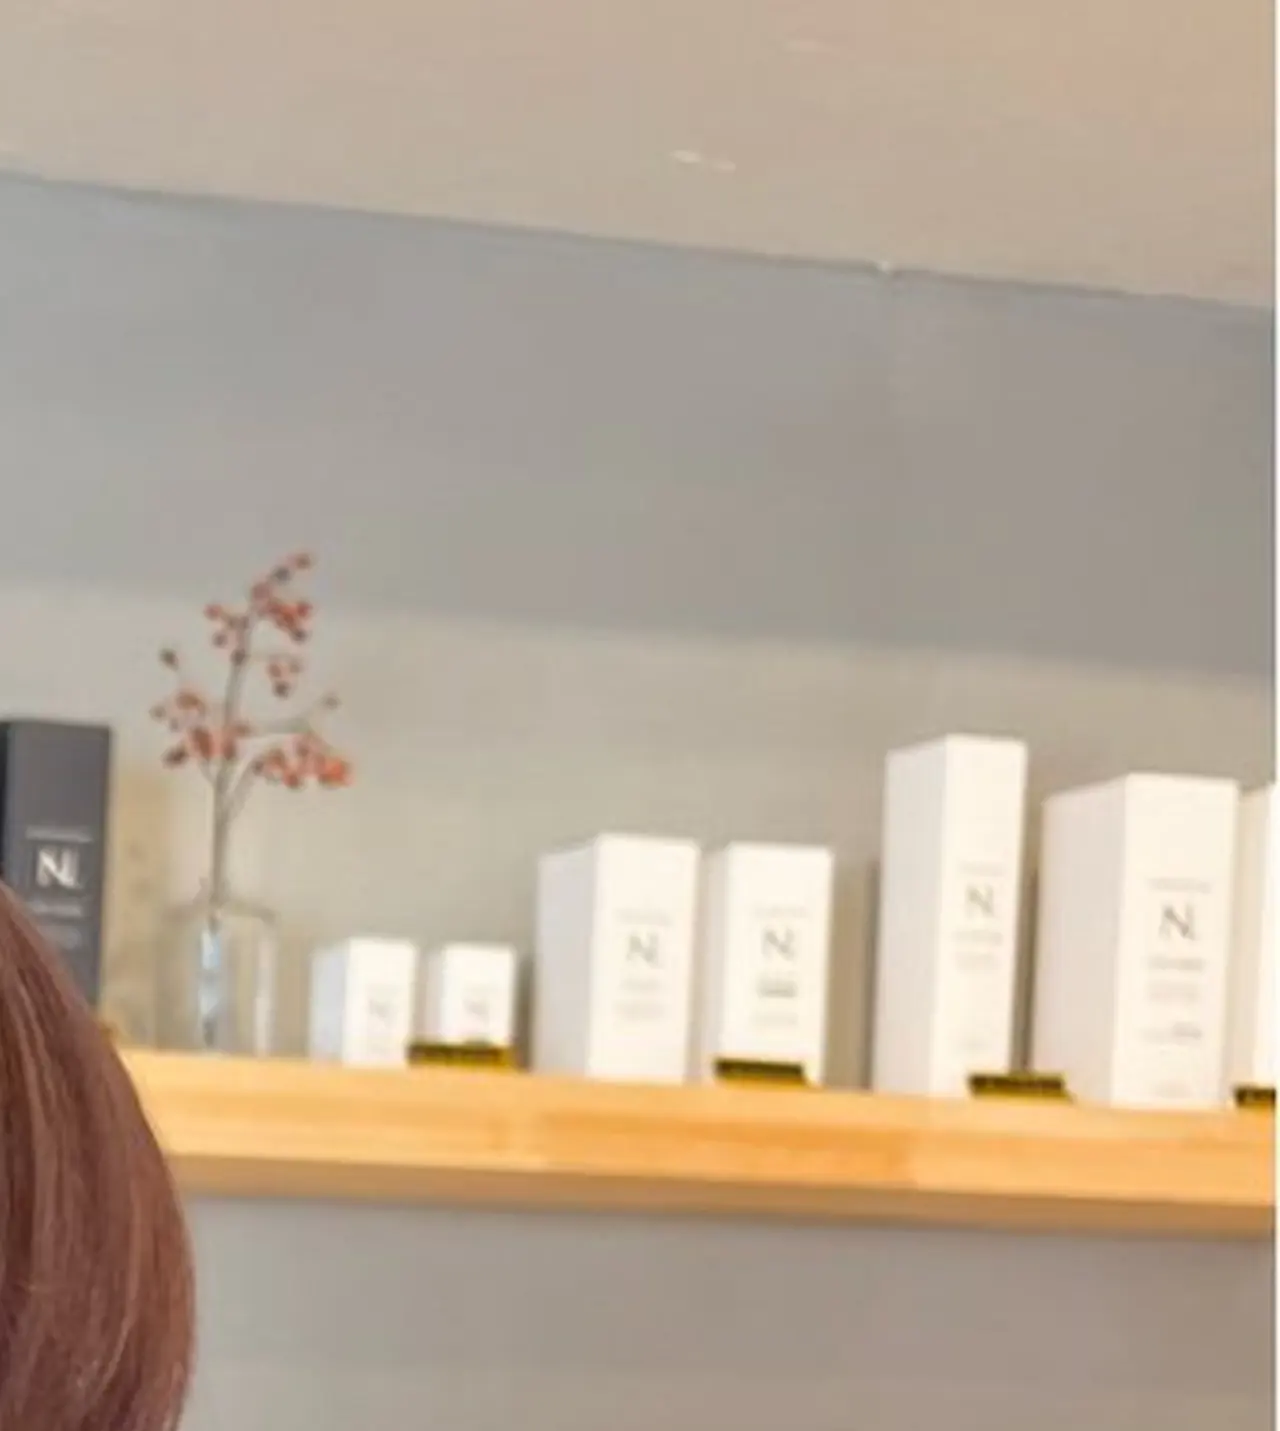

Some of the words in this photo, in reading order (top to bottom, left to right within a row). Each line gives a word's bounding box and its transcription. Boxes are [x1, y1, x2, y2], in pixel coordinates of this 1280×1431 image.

[36, 847, 82, 889] N
[1158, 903, 1196, 942] N
[626, 930, 659, 967] N
[760, 926, 796, 962] N
